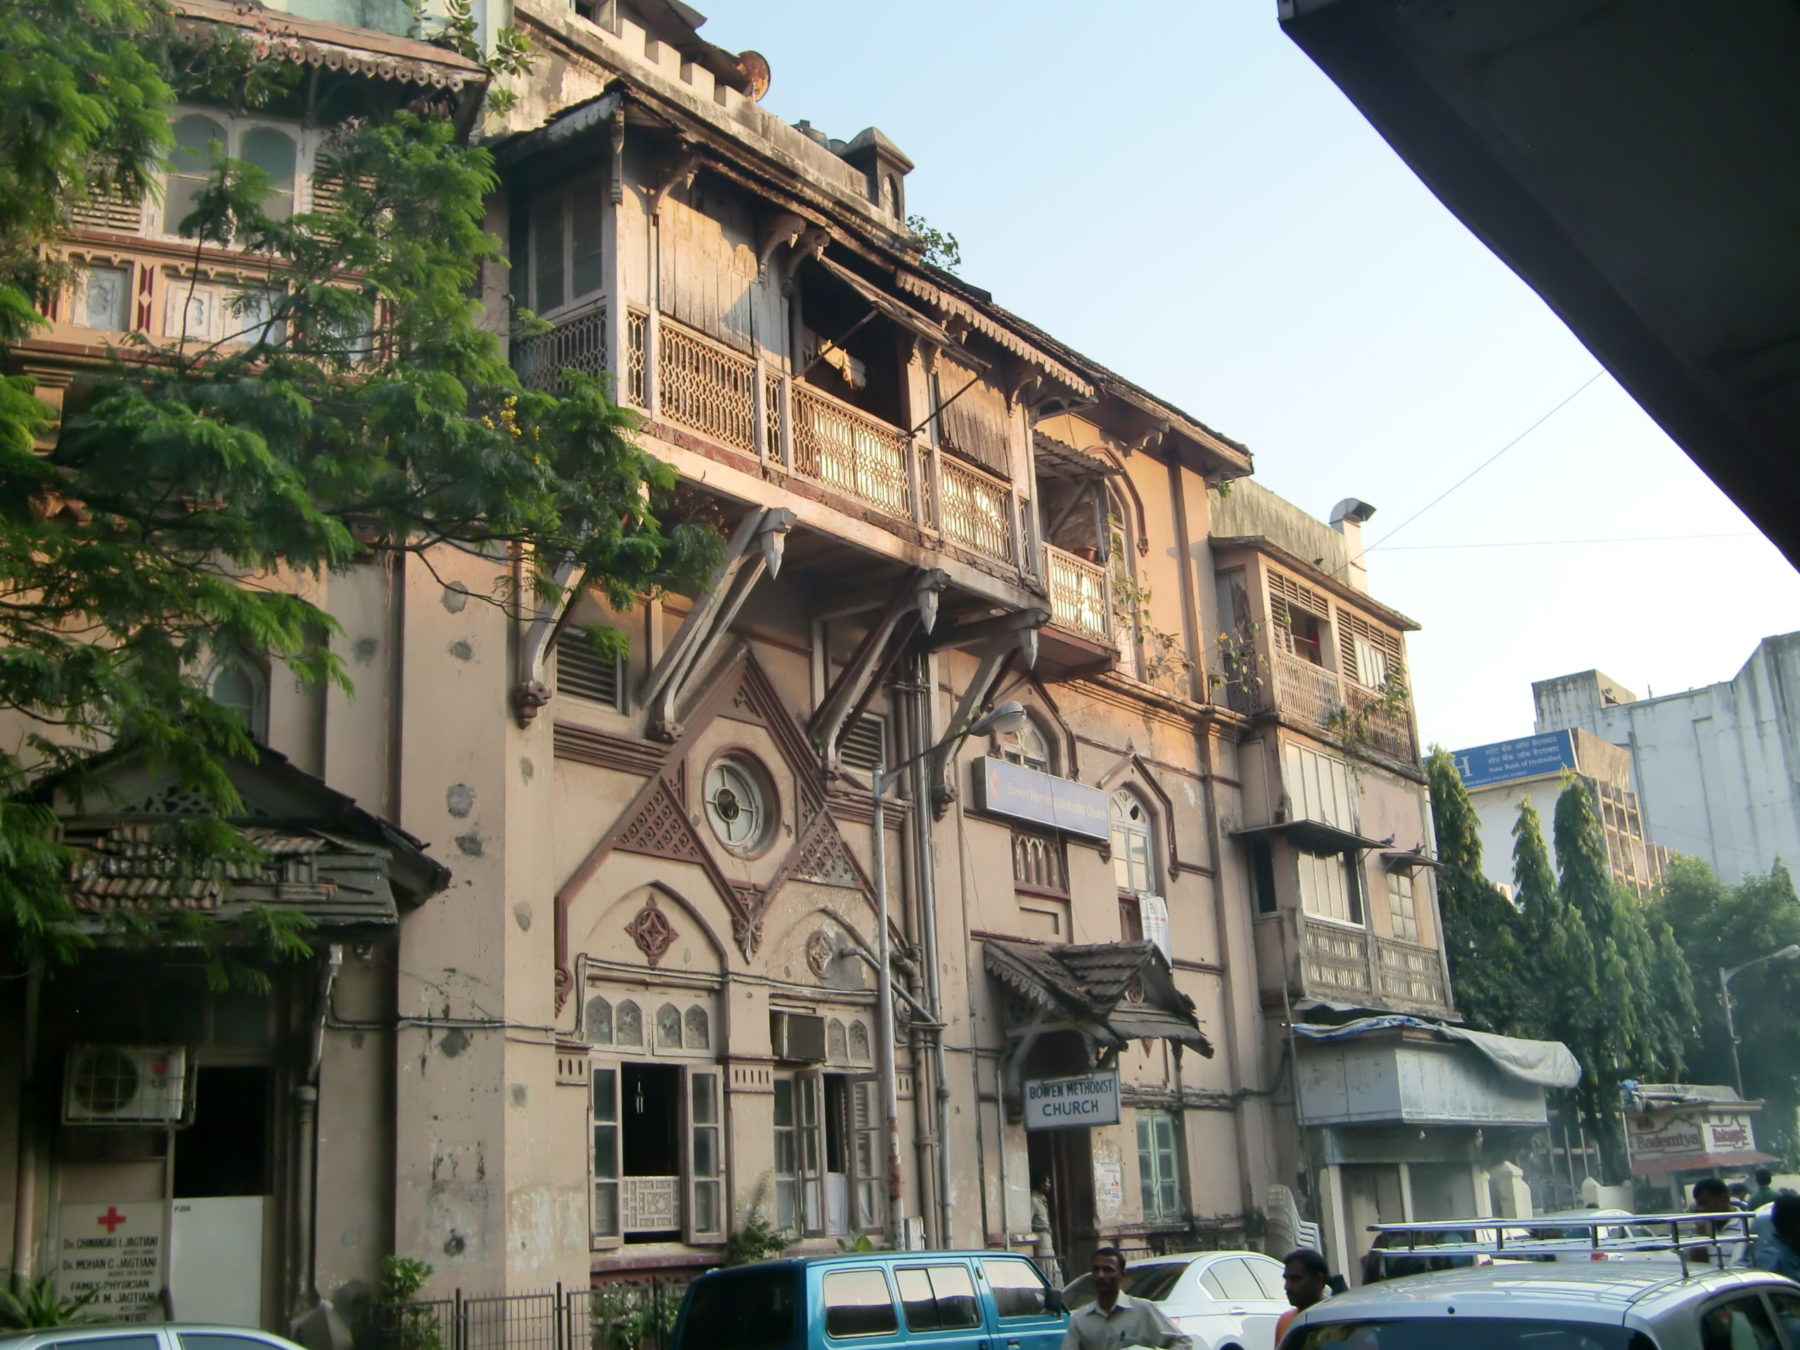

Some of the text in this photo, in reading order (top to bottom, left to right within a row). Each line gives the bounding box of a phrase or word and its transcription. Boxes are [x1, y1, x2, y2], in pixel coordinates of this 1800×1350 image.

[1504, 762, 1520, 770] Bank
[1029, 1079, 1113, 1099] BOWEN METHODIST
[1042, 1100, 1099, 1117] CHURCH
[76, 1258, 106, 1270] MOHAN
[117, 1257, 157, 1269] JAGTIANI
[104, 1279, 149, 1290] PHYSICIAN
